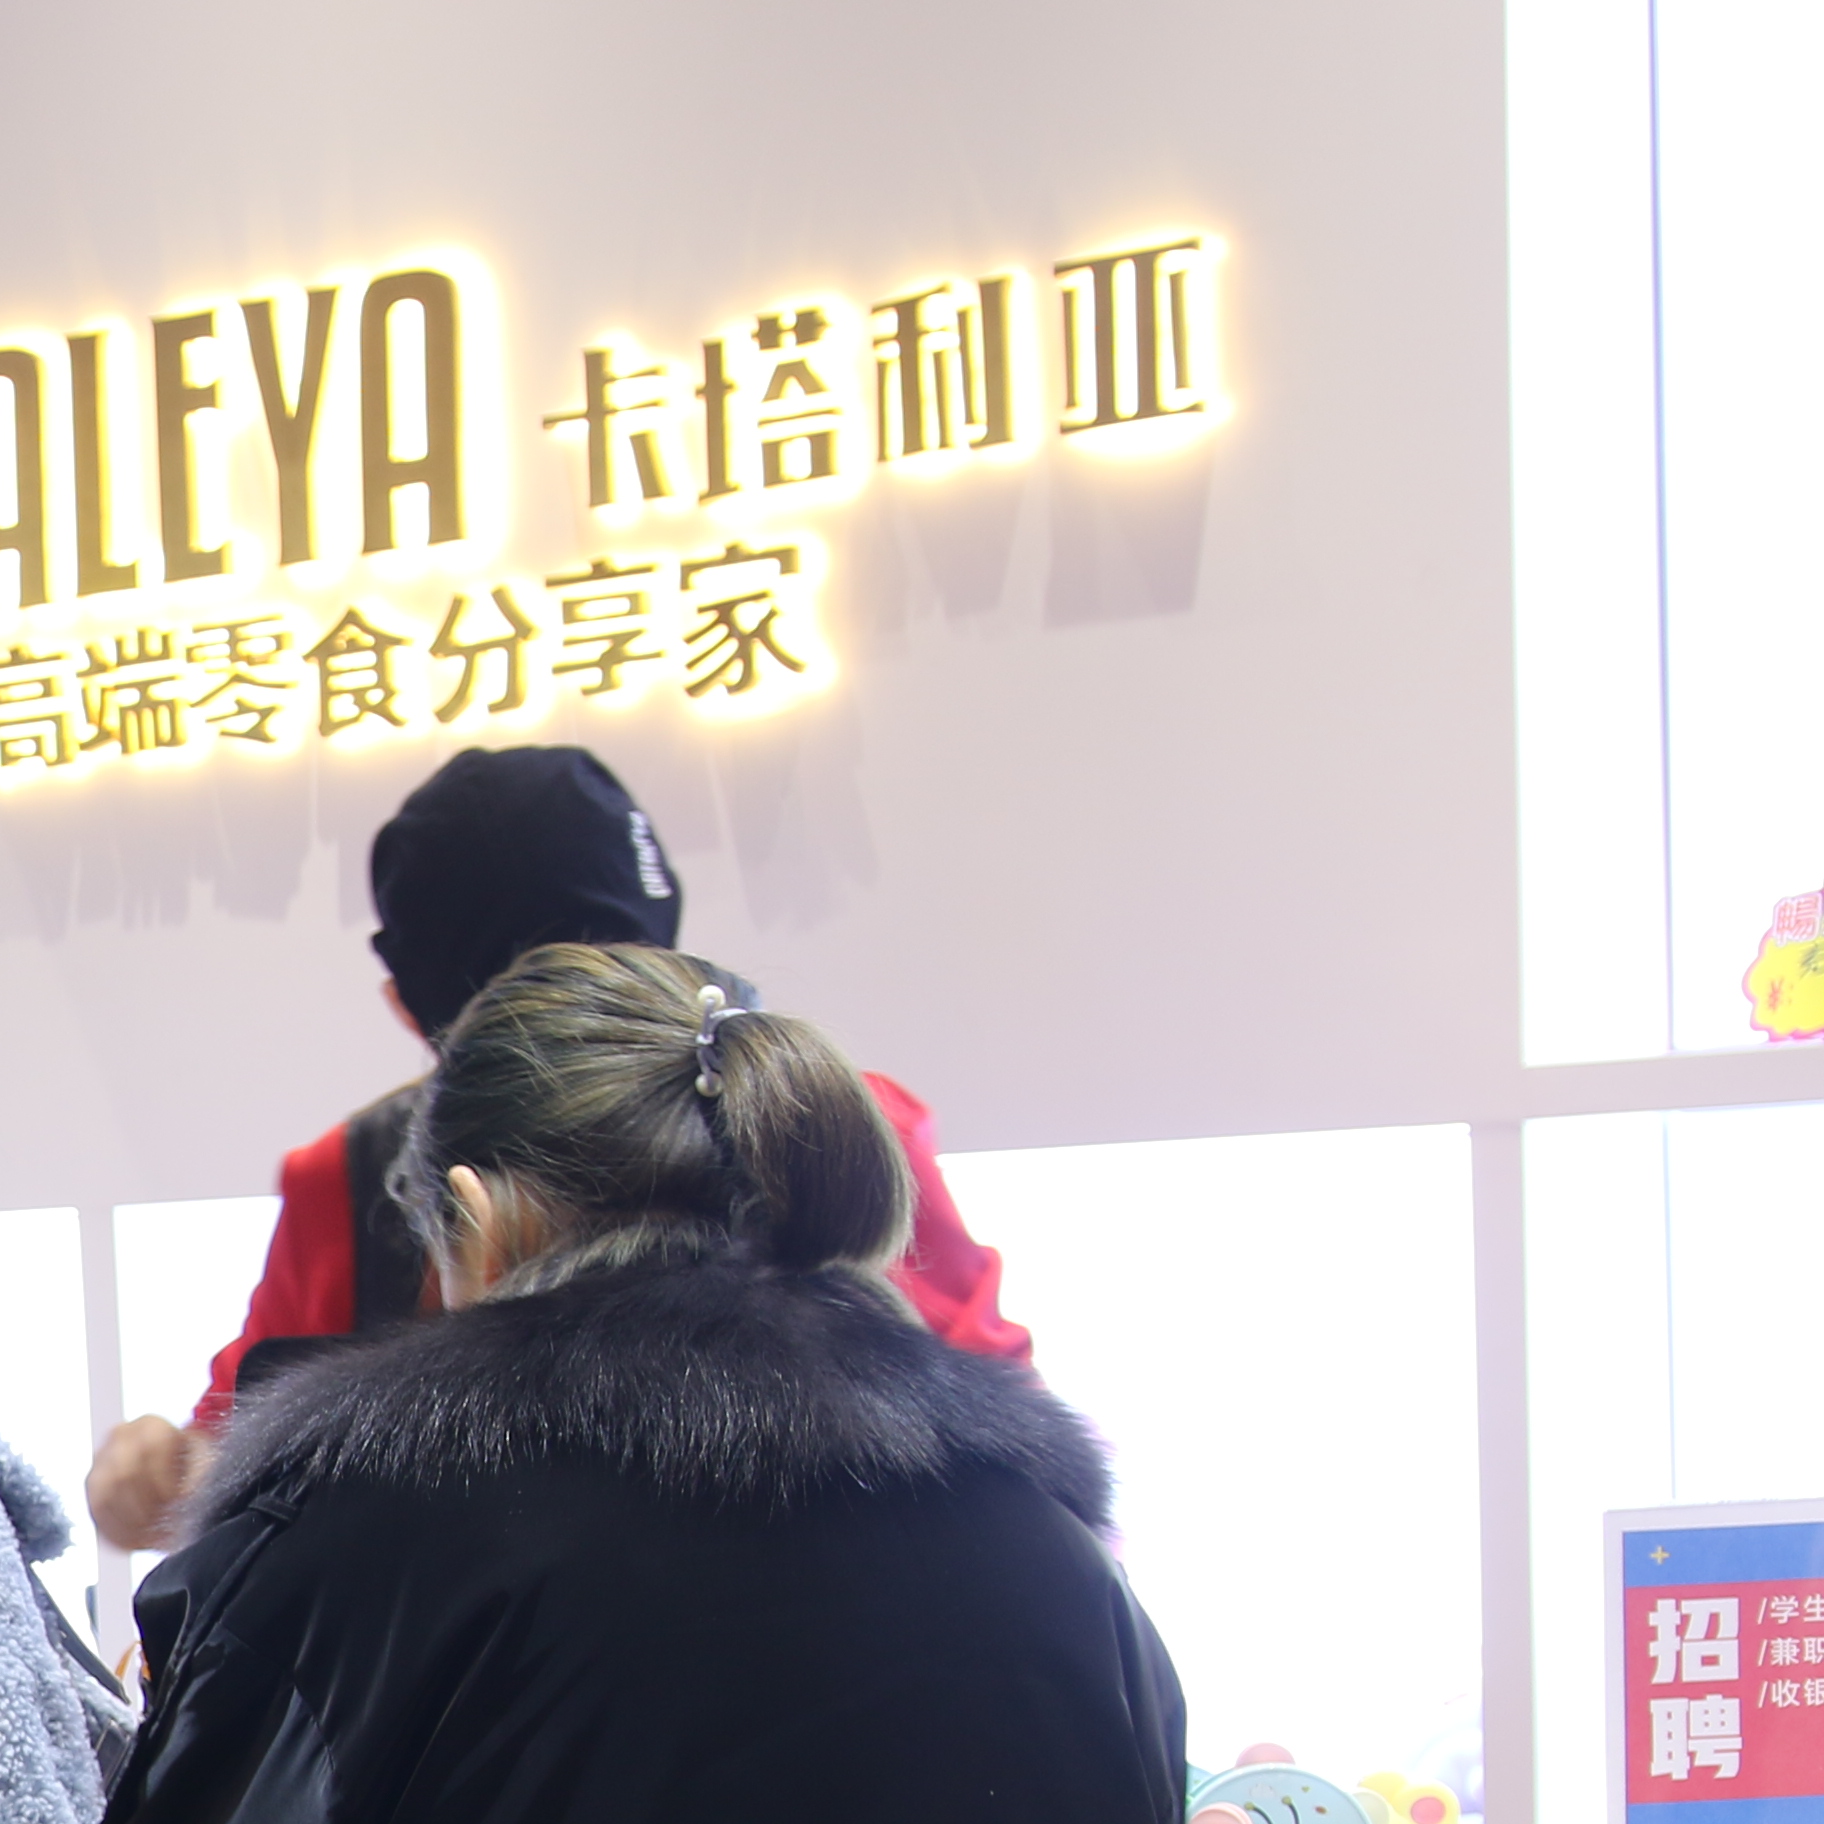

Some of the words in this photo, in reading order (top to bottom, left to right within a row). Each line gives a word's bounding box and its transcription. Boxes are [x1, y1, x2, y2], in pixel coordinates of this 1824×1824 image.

[540, 239, 1204, 508] 卡塔利亚
[1648, 1597, 1743, 1780] 招聘
